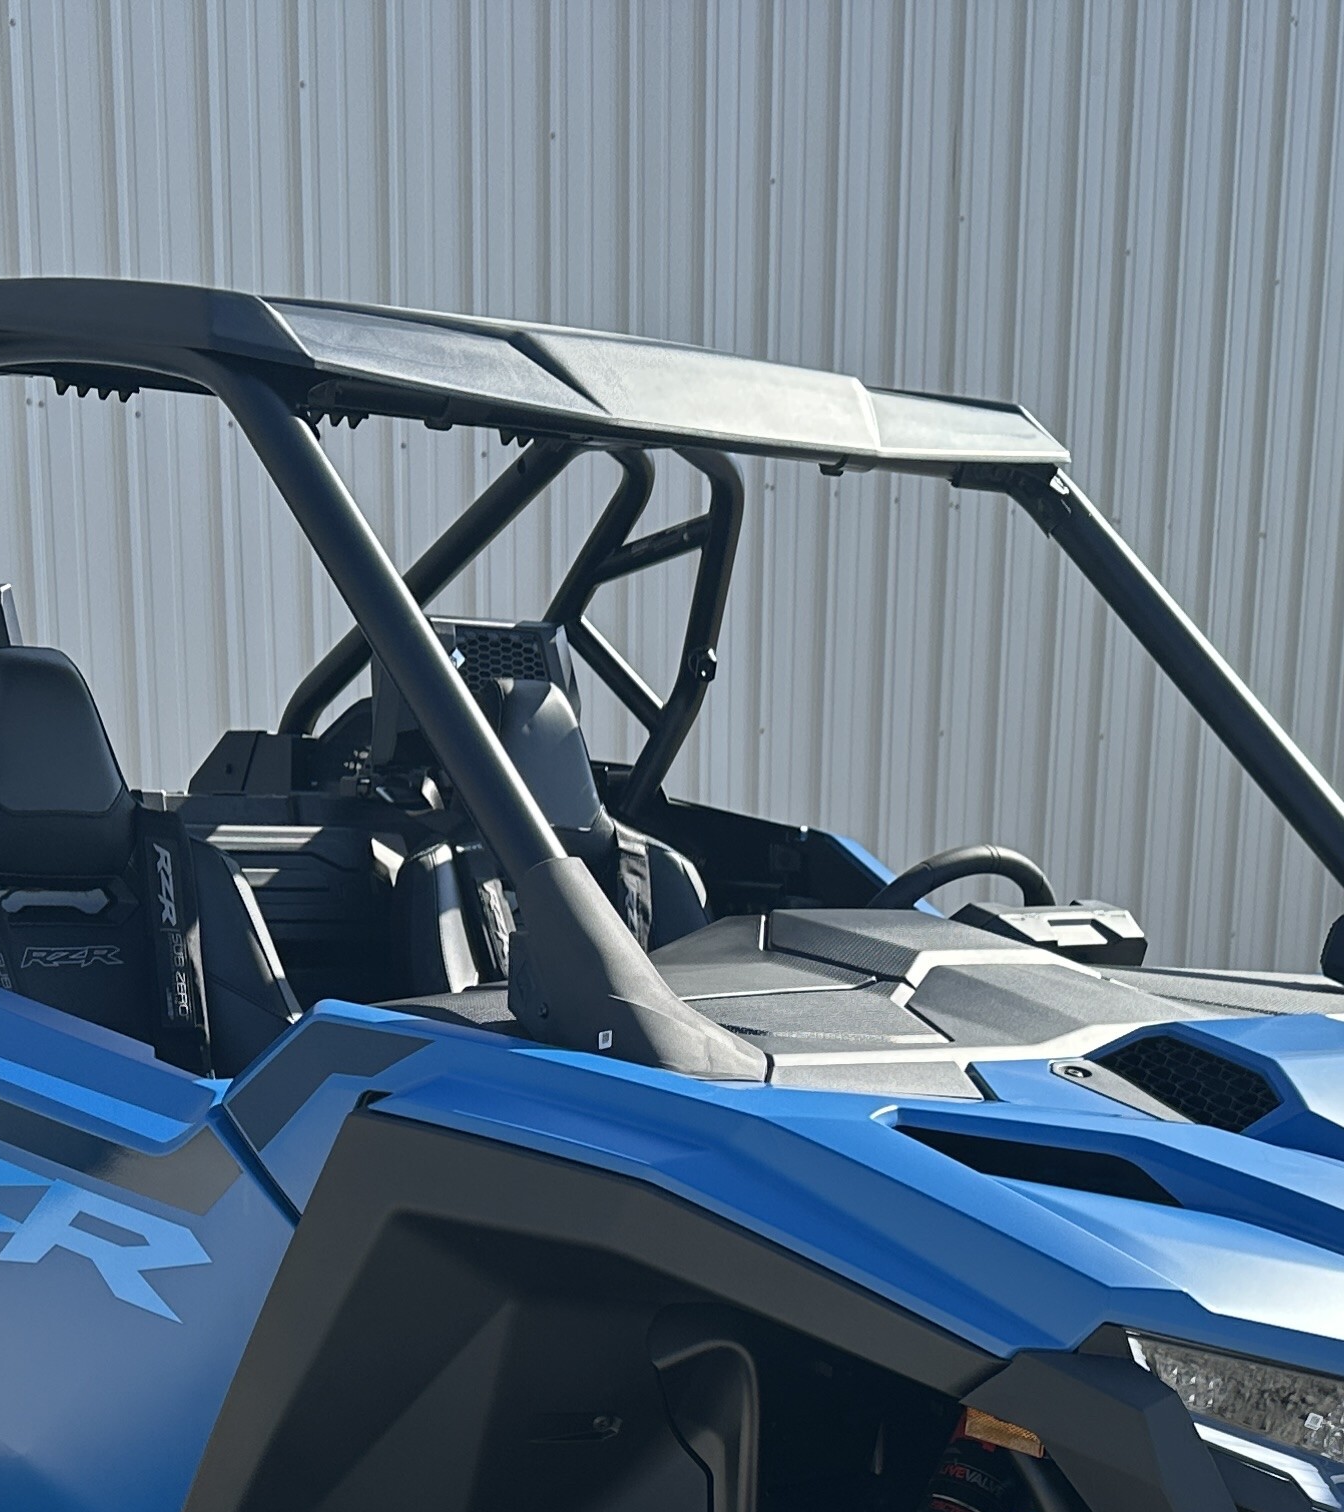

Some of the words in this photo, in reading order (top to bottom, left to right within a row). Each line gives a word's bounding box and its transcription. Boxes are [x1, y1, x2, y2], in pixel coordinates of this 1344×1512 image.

[153, 842, 177, 928] RZR
[21, 945, 124, 968] RZR
[171, 932, 185, 968] SUB
[175, 971, 189, 1016] ZERO
